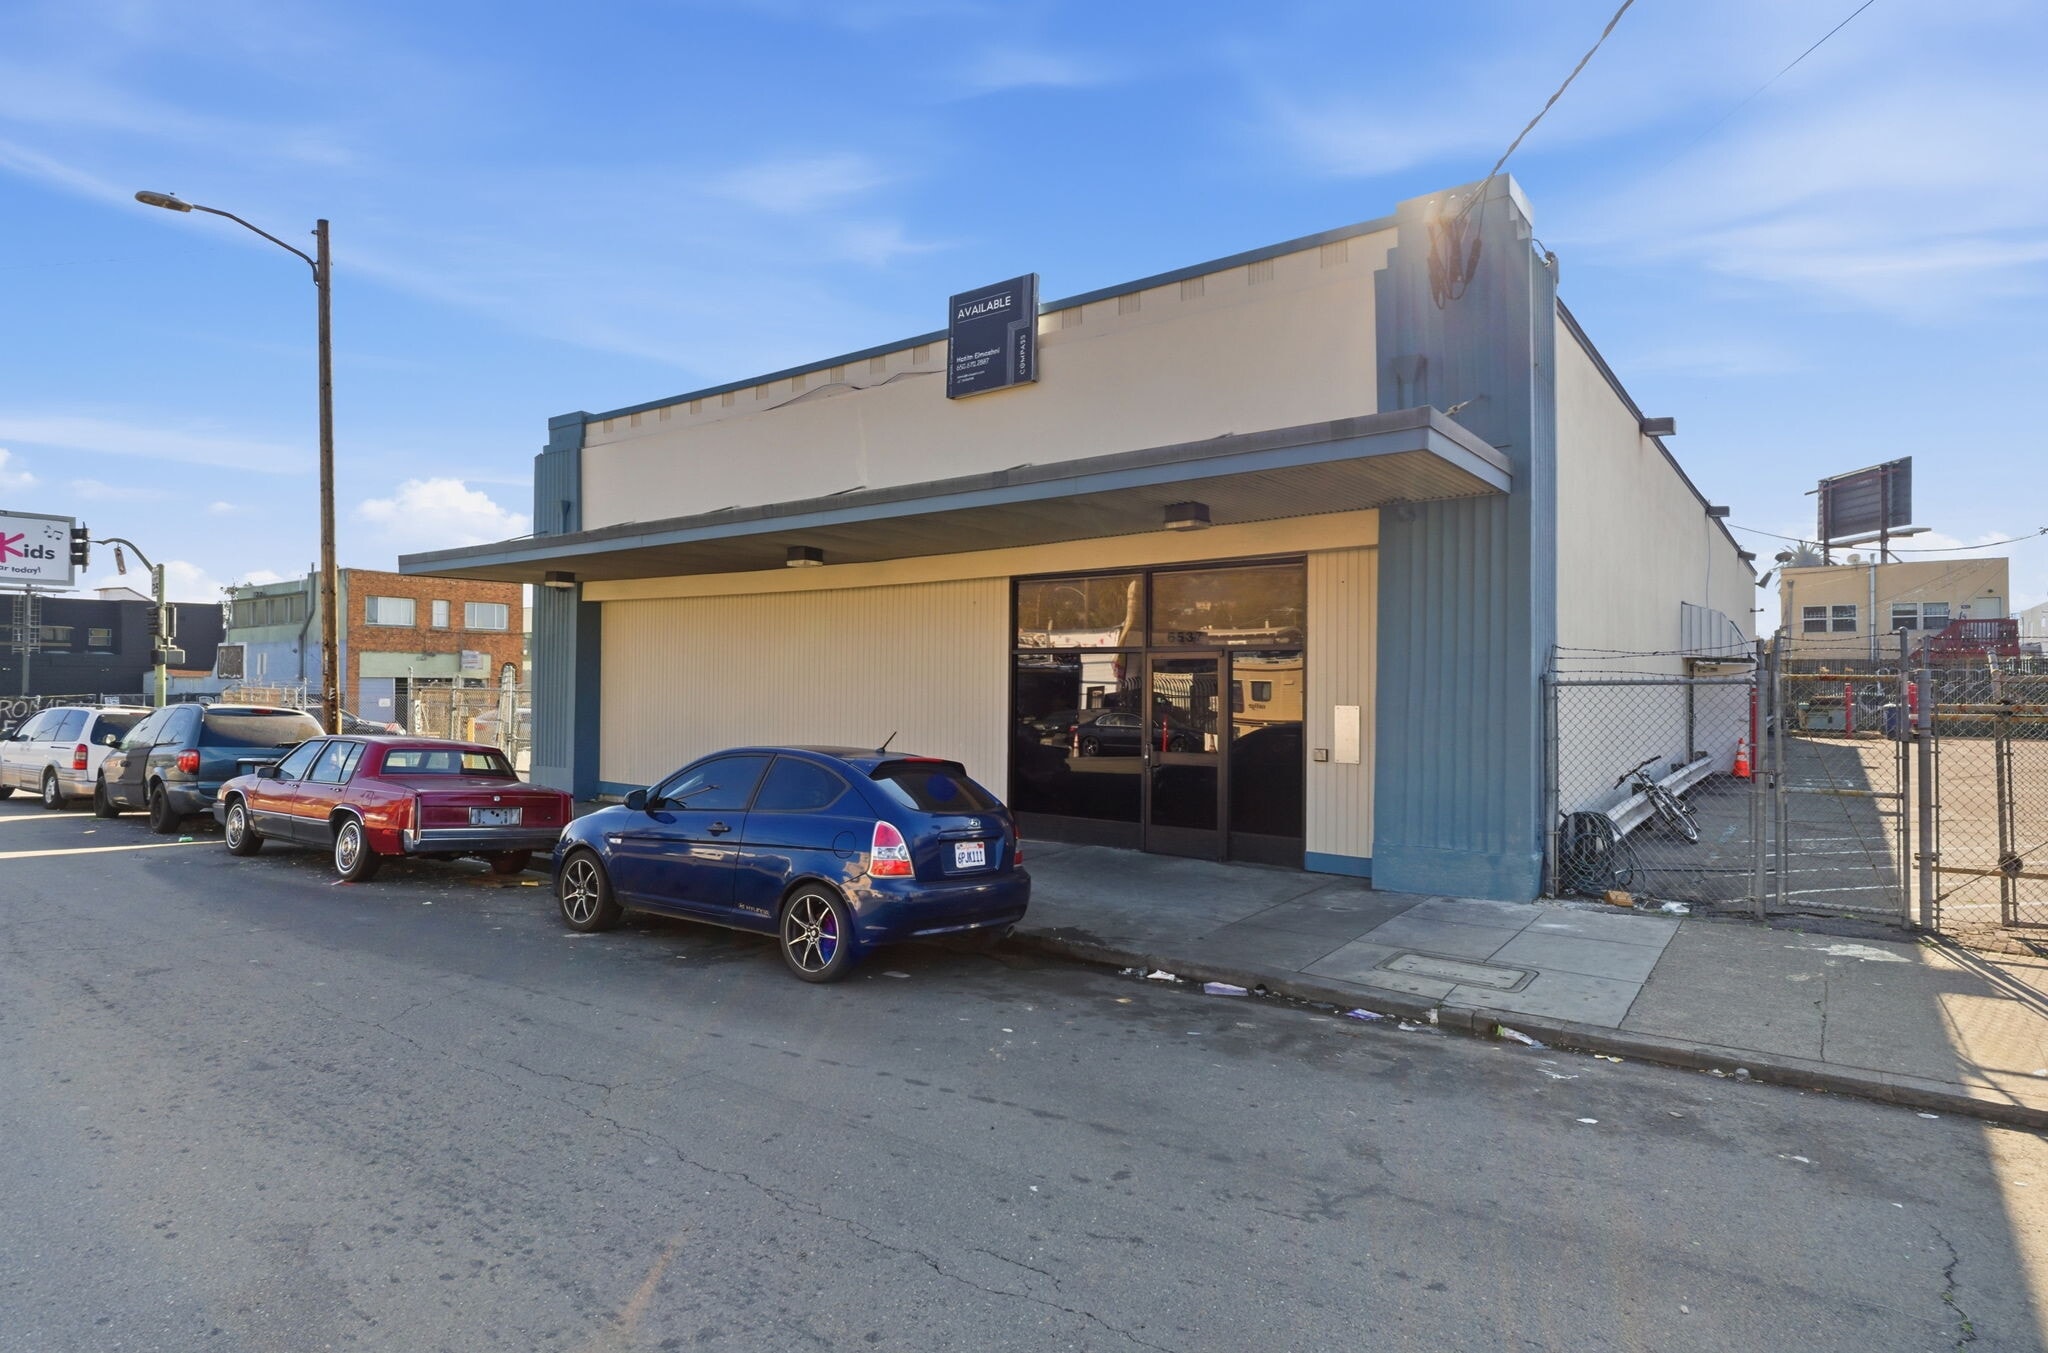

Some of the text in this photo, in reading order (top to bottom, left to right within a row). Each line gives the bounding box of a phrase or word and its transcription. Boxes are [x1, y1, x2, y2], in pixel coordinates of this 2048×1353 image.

[957, 296, 1012, 319] AVAILABLE
[1018, 334, 1027, 375] COMPASS
[0, 531, 55, 563] Kids
[11, 566, 41, 575] today!
